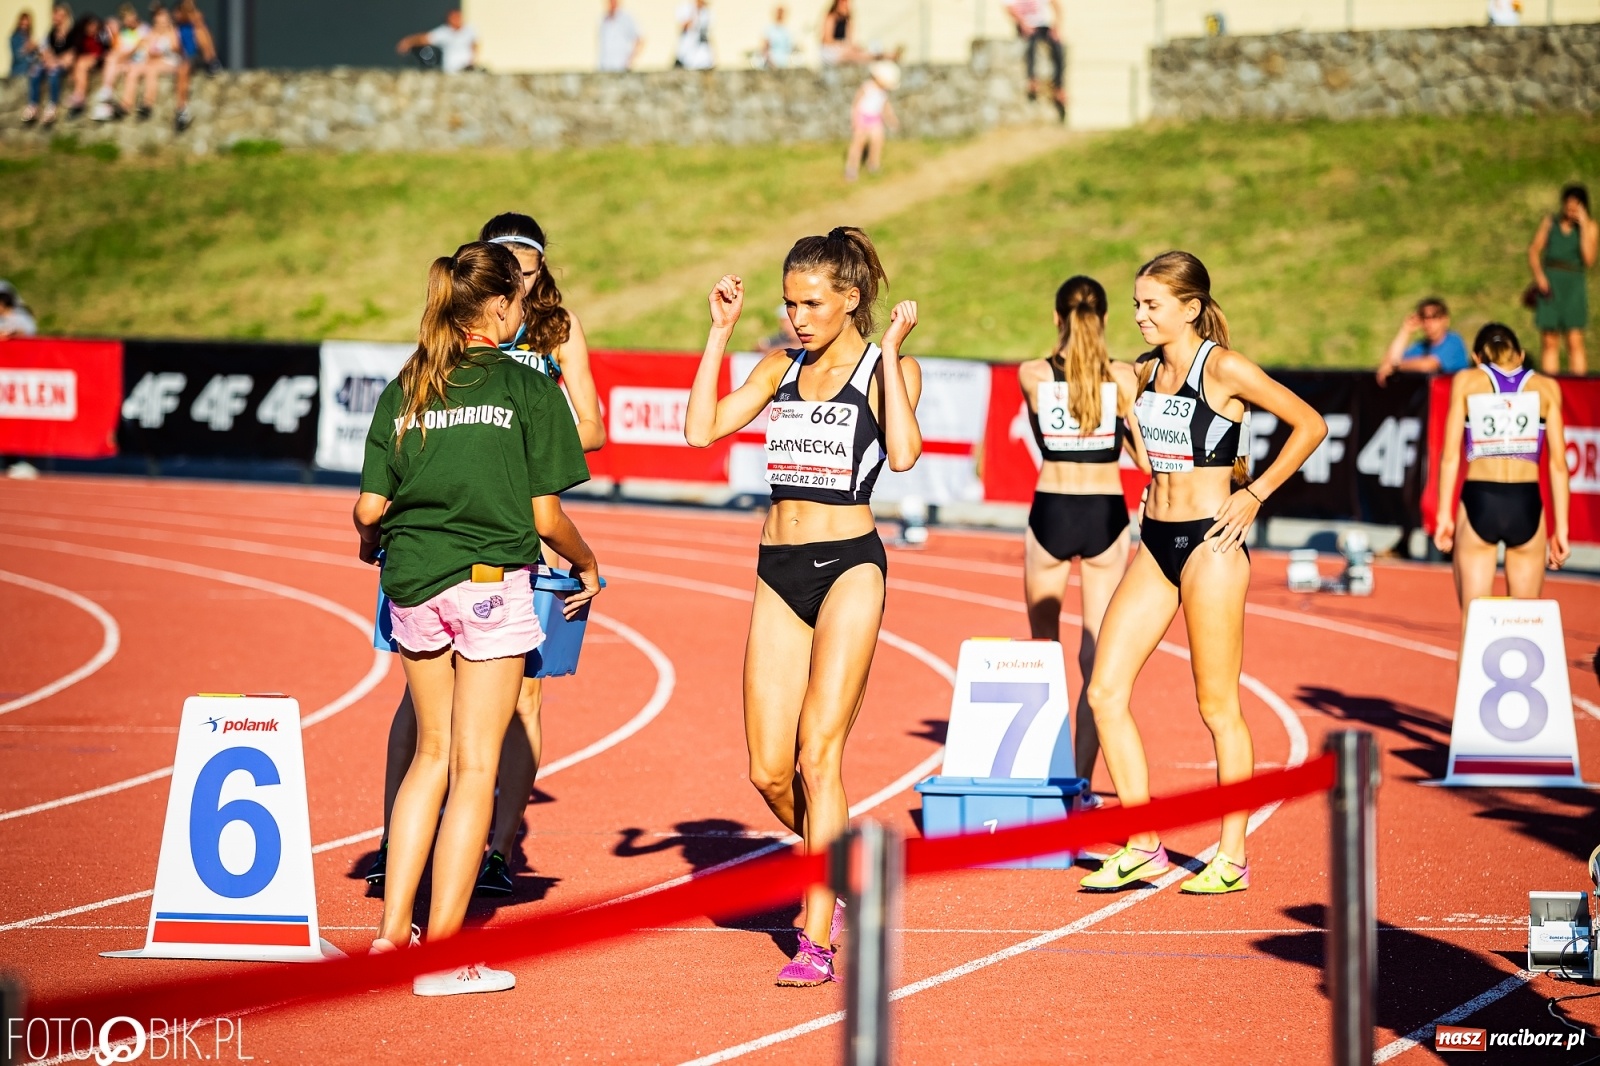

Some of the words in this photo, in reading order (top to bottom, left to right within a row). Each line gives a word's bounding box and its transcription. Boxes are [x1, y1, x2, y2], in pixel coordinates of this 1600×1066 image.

[122, 371, 187, 429] 4F
[190, 373, 254, 431] 4F
[256, 375, 318, 433] 4F
[1162, 398, 1191, 418] 253
[810, 405, 852, 427] 662
[1482, 413, 1528, 437] 329
[1356, 415, 1422, 488] 4F
[1165, 461, 1183, 471] 2019
[770, 472, 810, 485] RACIBÓRZ
[811, 475, 837, 487] 2019
[996, 659, 1045, 671] polanik
[1479, 636, 1549, 742] 8
[223, 717, 280, 734] polanik
[970, 681, 1050, 779] 7
[189, 746, 282, 899] 6
